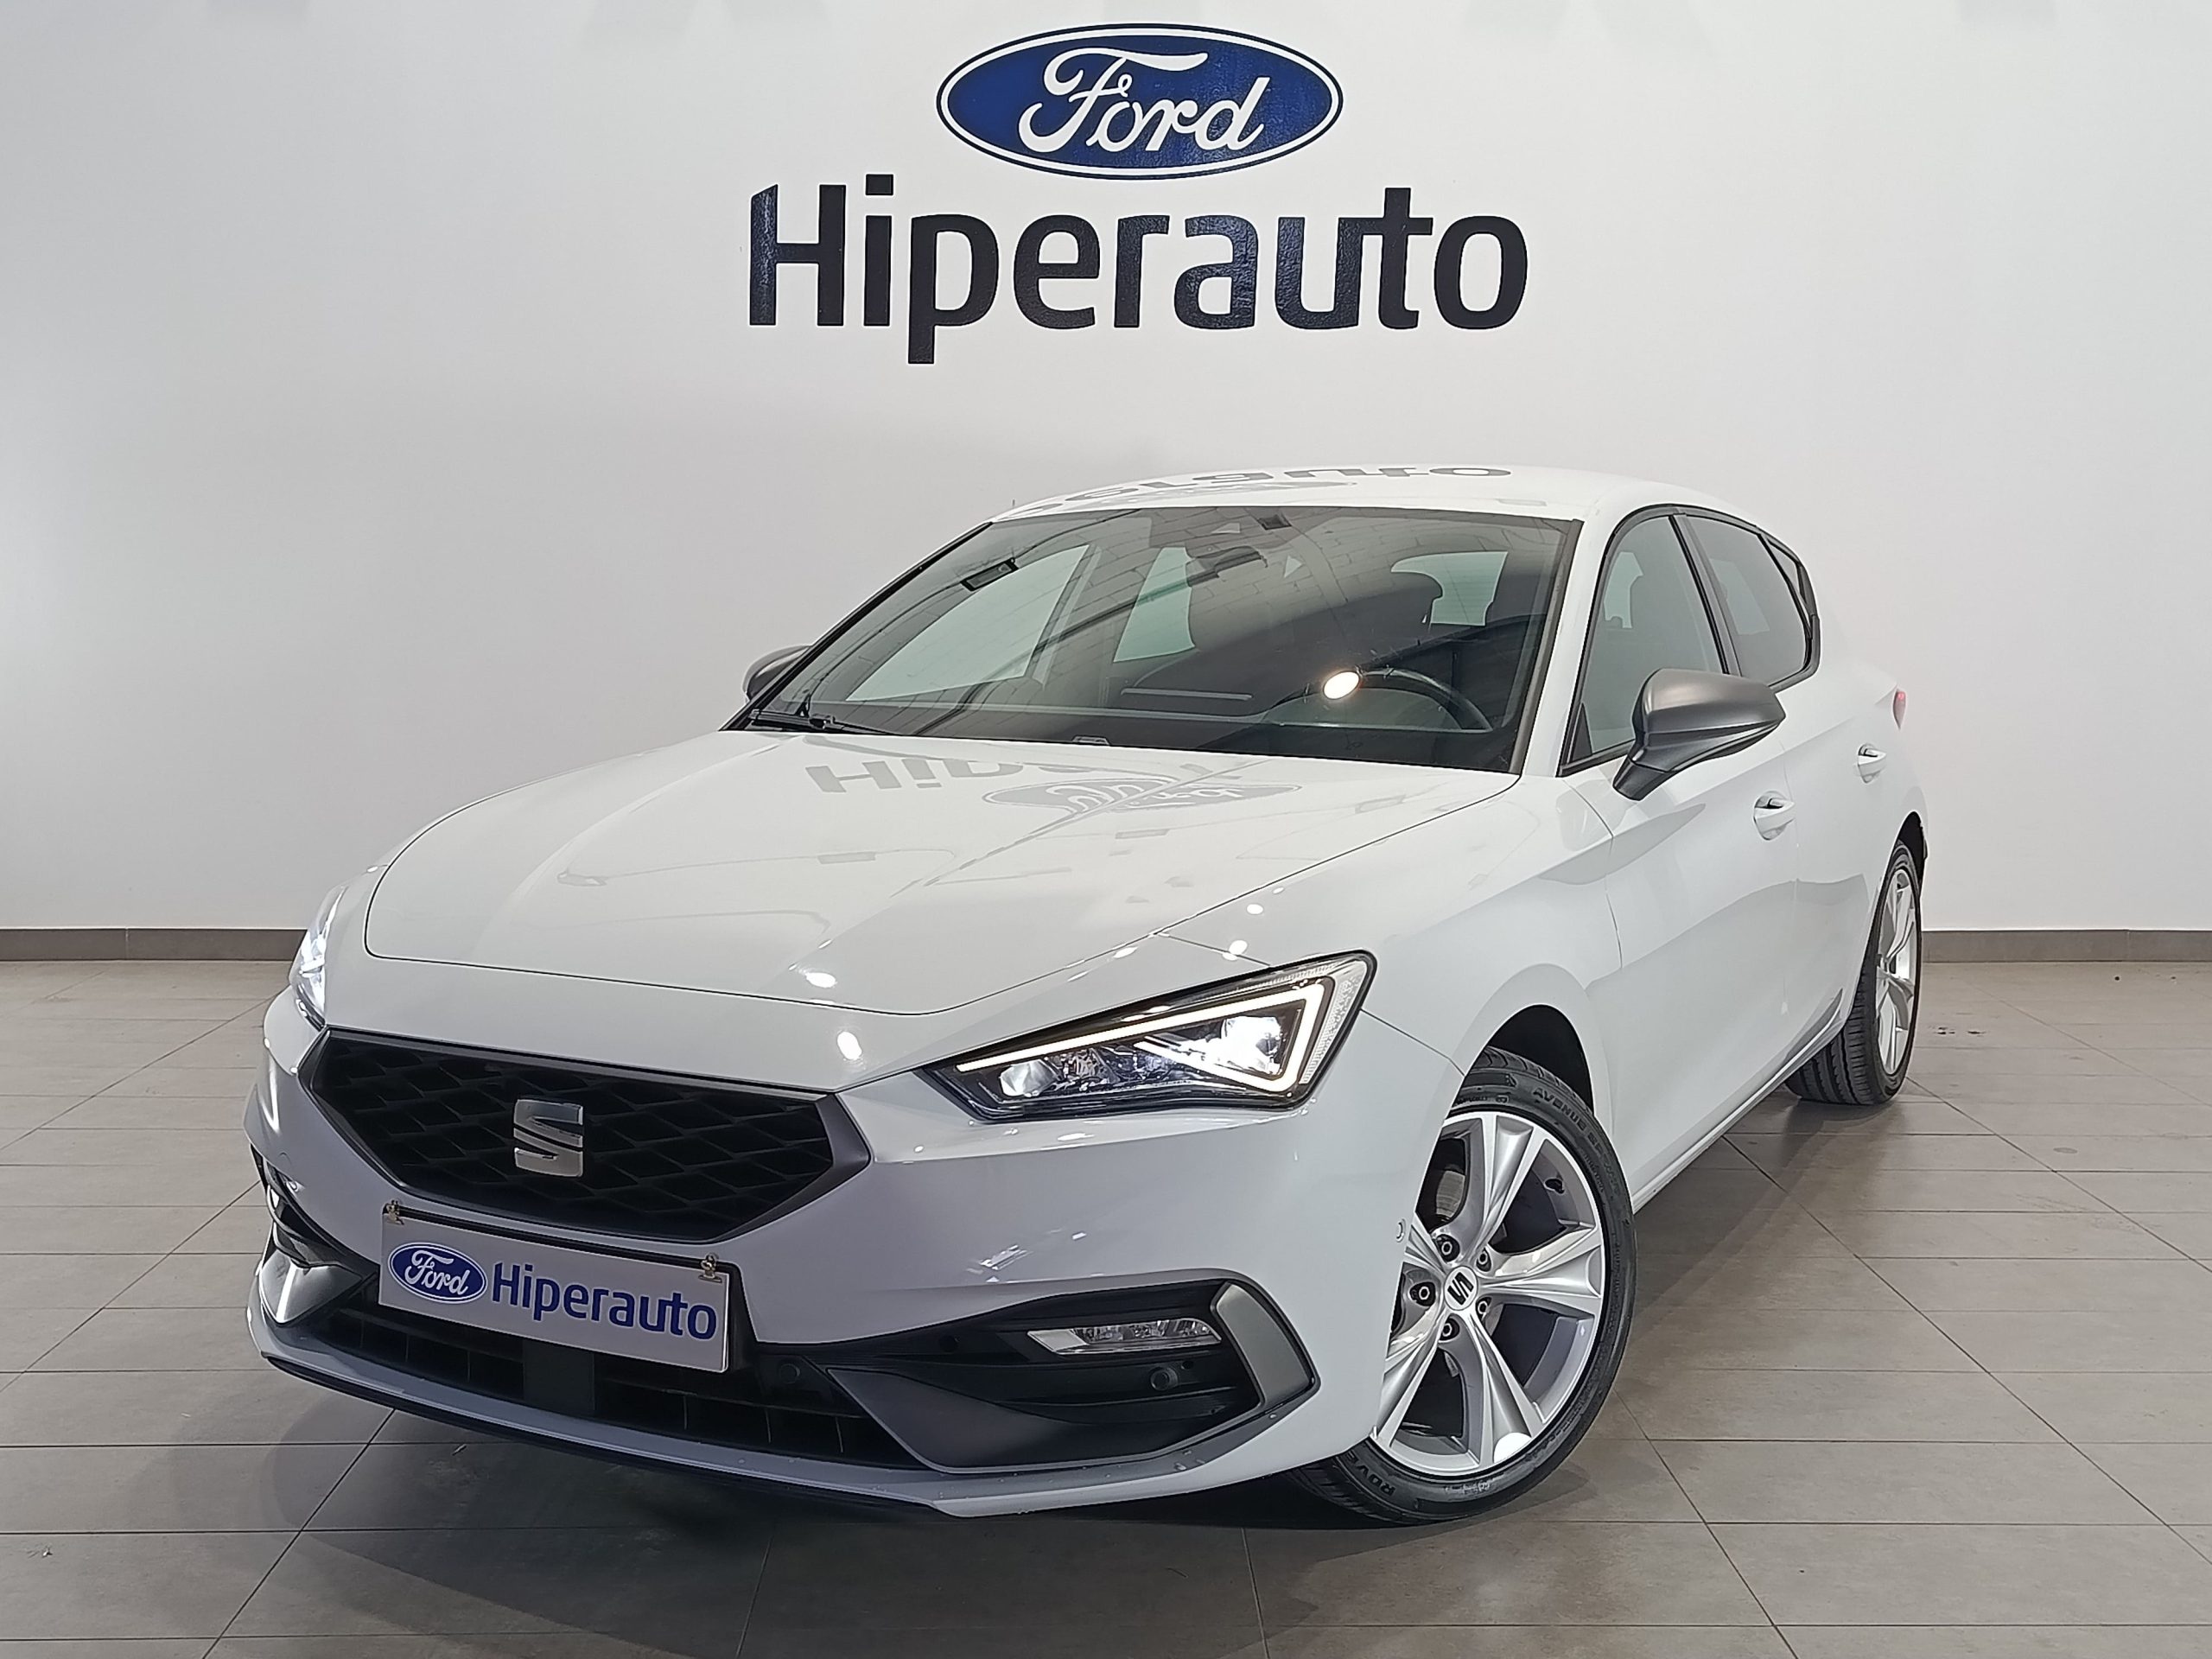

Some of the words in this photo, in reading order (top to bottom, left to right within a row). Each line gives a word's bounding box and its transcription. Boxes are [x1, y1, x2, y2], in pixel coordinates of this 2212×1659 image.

[1018, 47, 1270, 153] Ford
[749, 174, 1528, 364] Hiperauto
[404, 1249, 471, 1295] Ford
[493, 1262, 718, 1340] Hiperauto
[1345, 1449, 1396, 1497] ROVE
